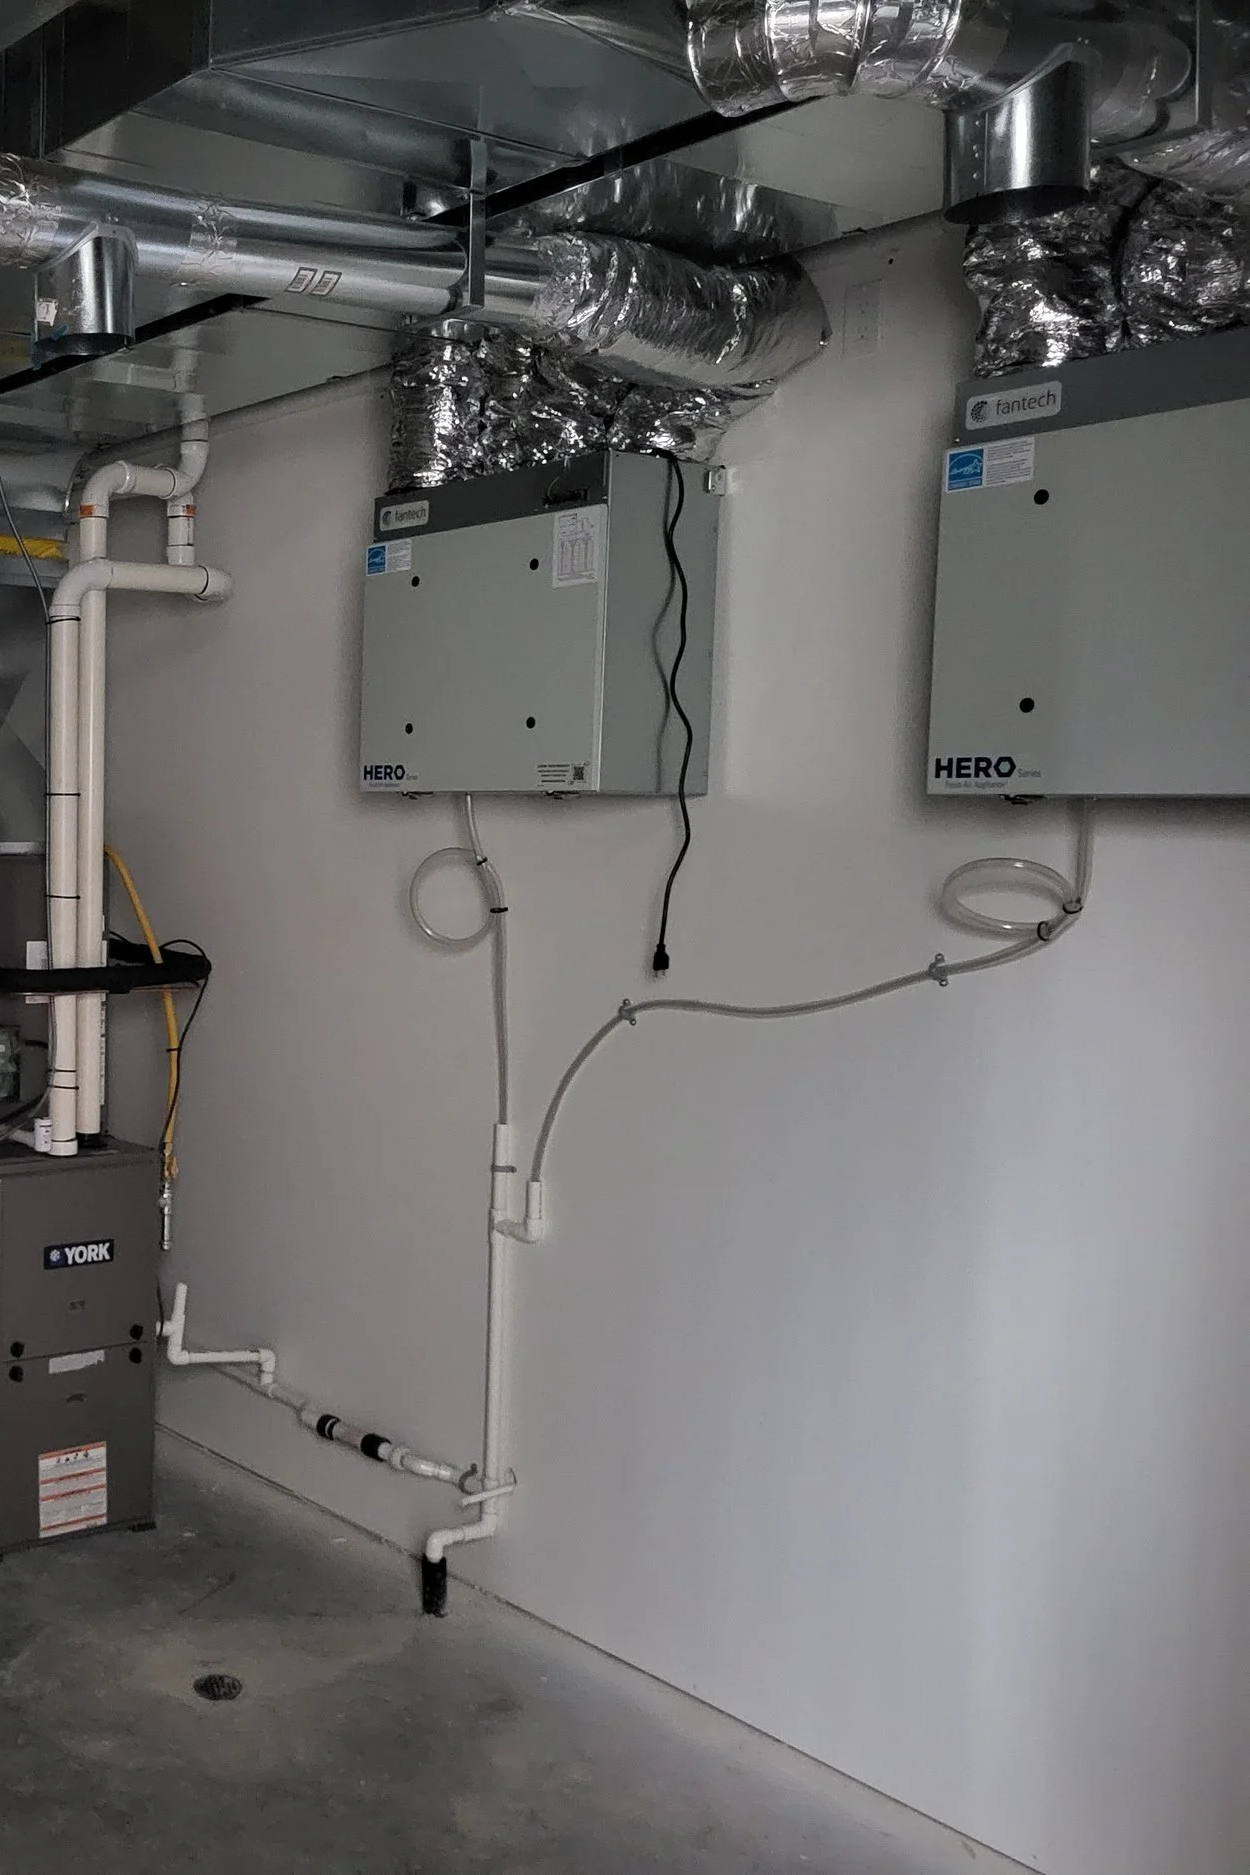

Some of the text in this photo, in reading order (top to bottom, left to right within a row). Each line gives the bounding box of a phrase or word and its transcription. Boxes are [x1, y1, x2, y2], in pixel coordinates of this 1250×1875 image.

[995, 389, 1056, 416] fantech
[394, 505, 427, 523] fantech
[363, 764, 406, 781] HERO
[934, 756, 1017, 779] HERO
[64, 1242, 111, 1265] YORK
